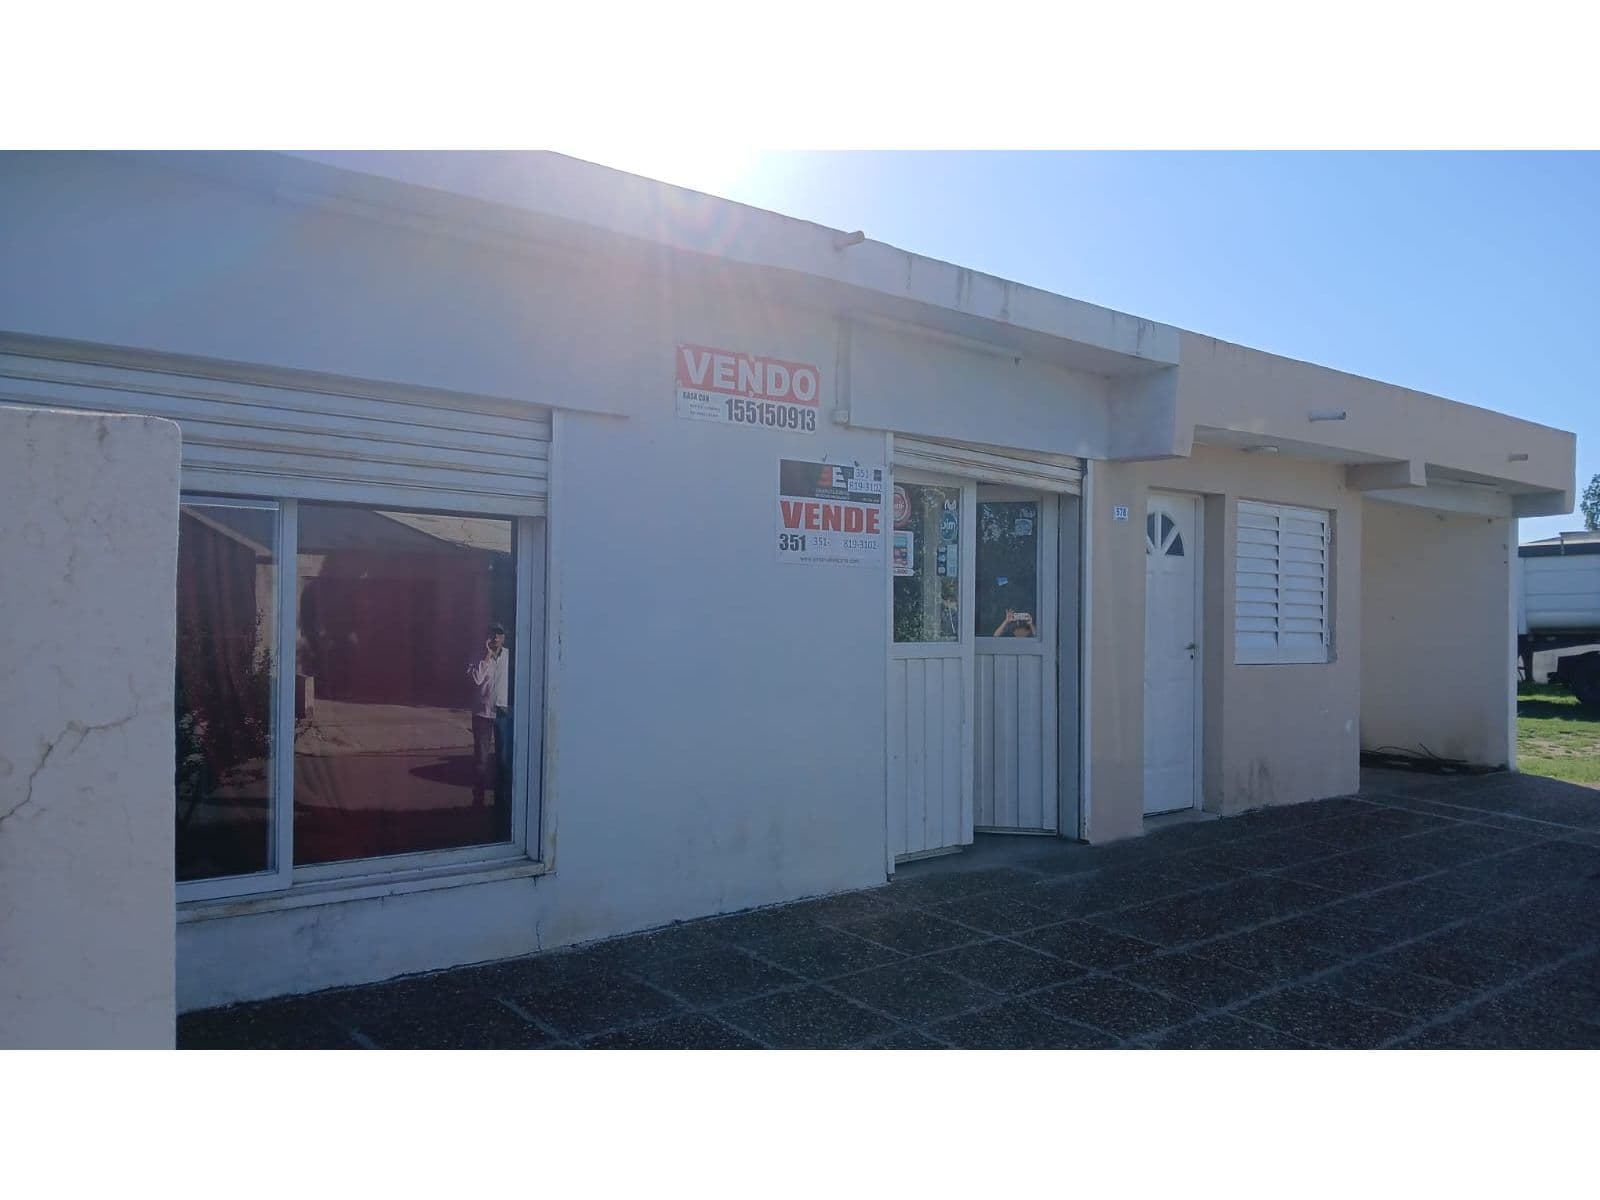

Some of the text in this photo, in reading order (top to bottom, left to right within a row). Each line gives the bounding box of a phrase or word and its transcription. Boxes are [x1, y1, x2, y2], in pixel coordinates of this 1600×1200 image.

[681, 348, 817, 401] VENDO
[725, 398, 816, 432] 155150913
[779, 500, 881, 534] VENDE
[779, 533, 806, 551] 351
